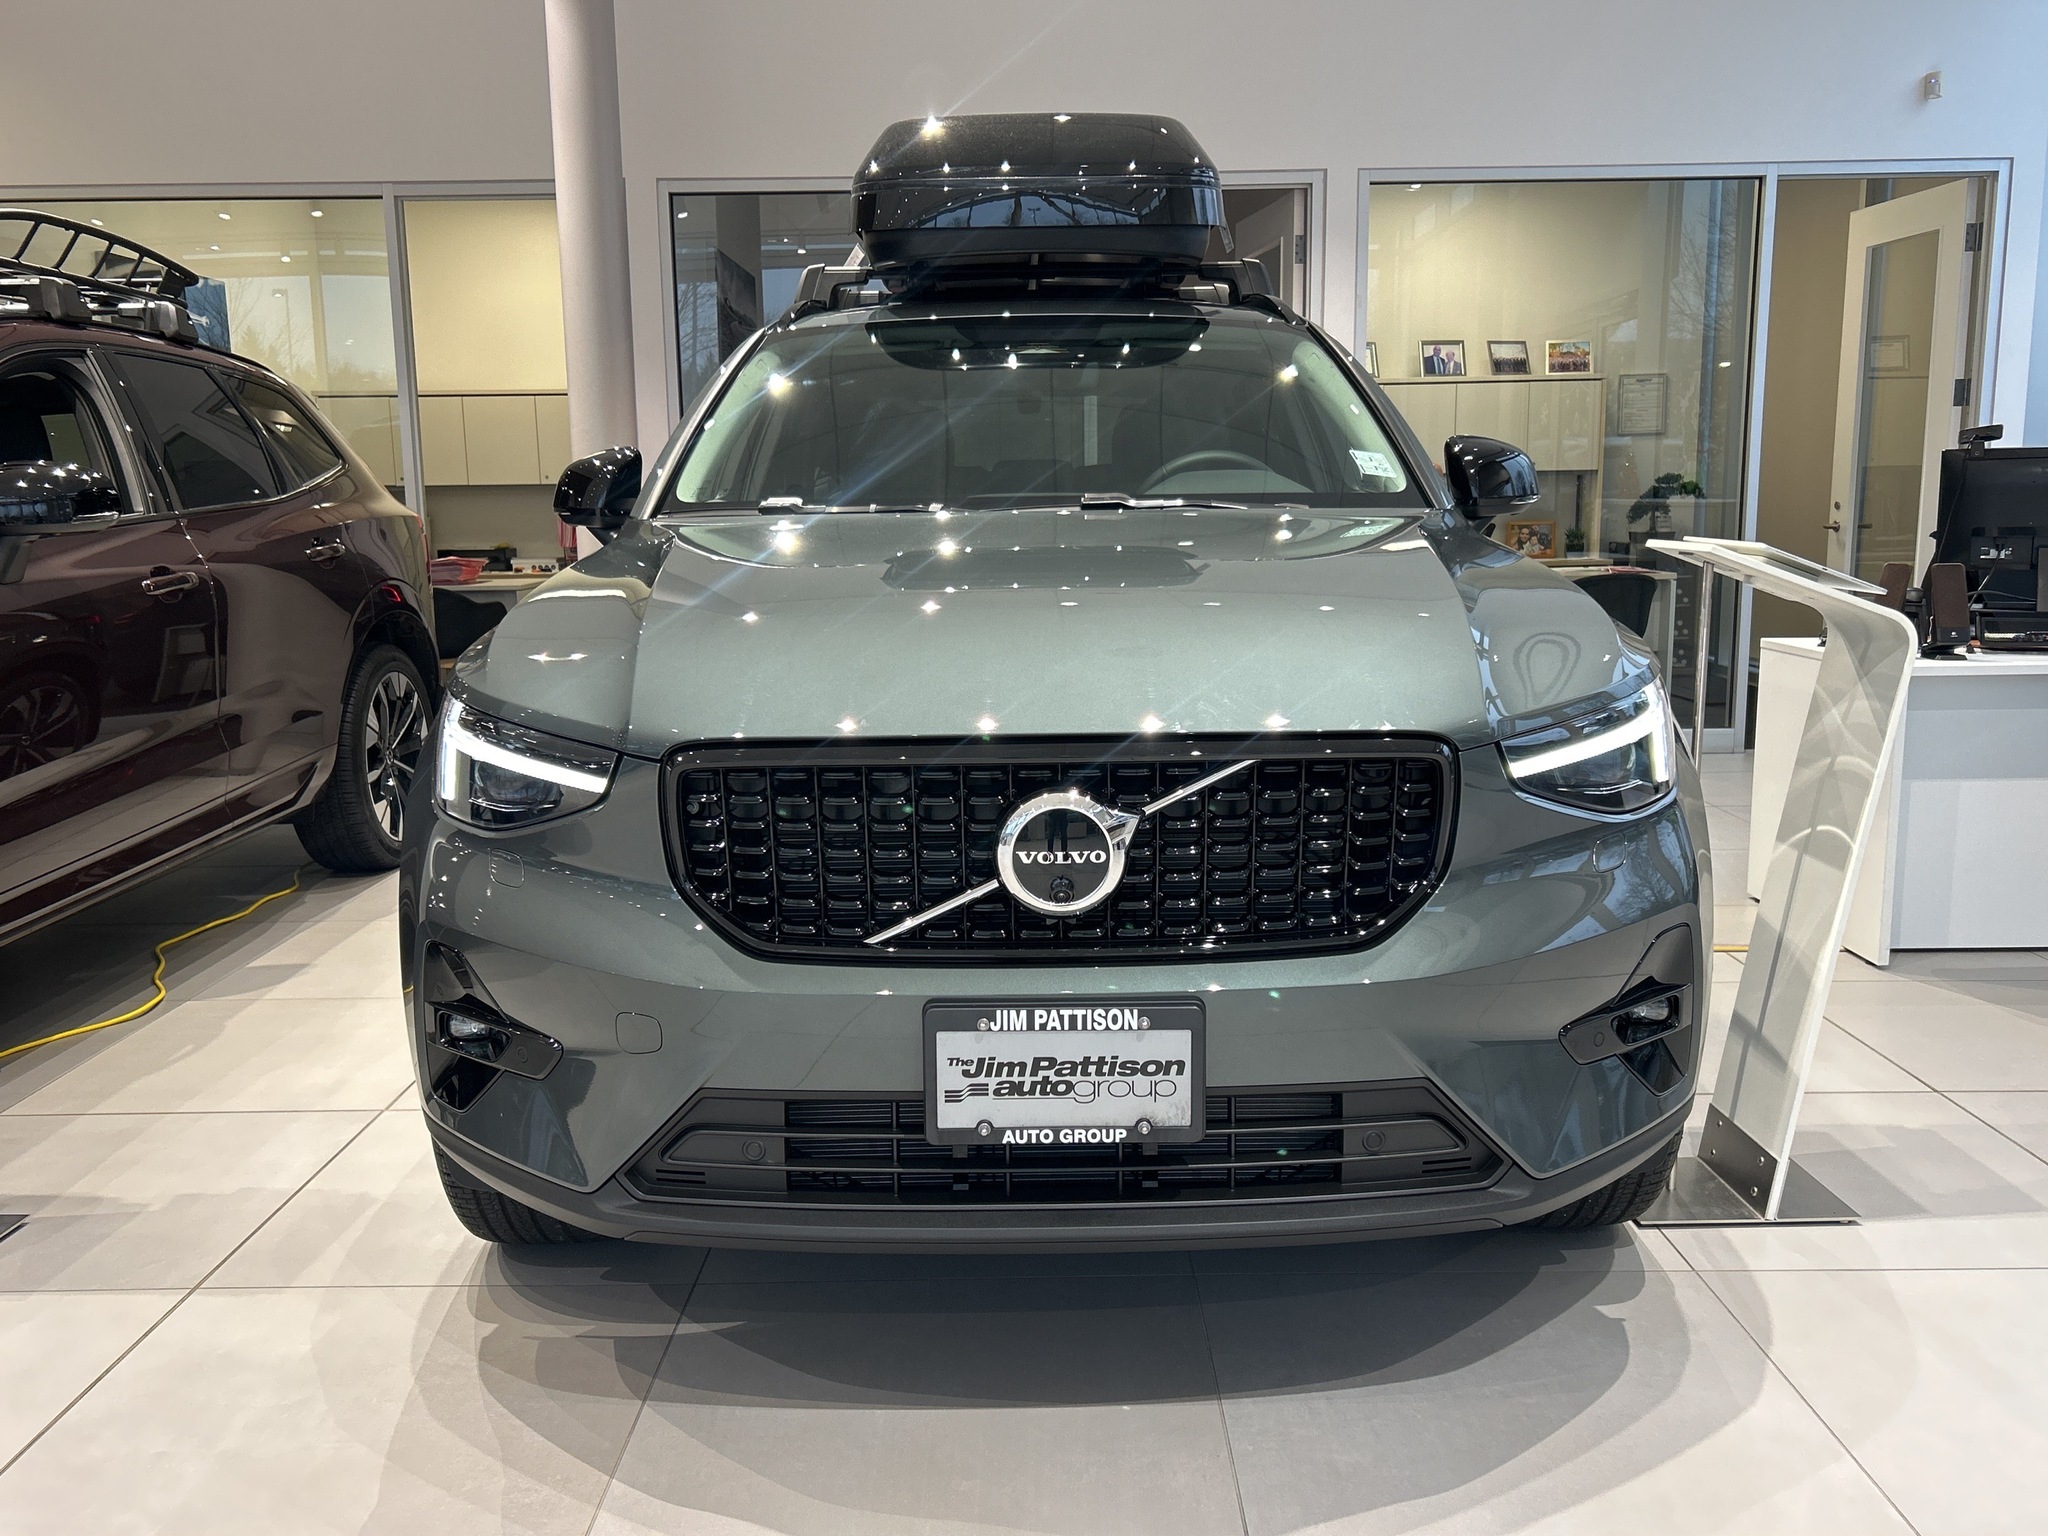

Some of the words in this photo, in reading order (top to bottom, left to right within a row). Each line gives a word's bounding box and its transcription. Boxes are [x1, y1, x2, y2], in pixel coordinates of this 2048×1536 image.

[1016, 850, 1107, 865] VOLVO
[989, 1009, 1027, 1032] JIM
[1034, 1009, 1139, 1031] PATTISON
[947, 1057, 974, 1067] The
[962, 1056, 1028, 1079] Jim
[1029, 1055, 1186, 1078] Pattison
[1002, 1129, 1054, 1144] AUTO
[1059, 1128, 1127, 1144] GROUP
